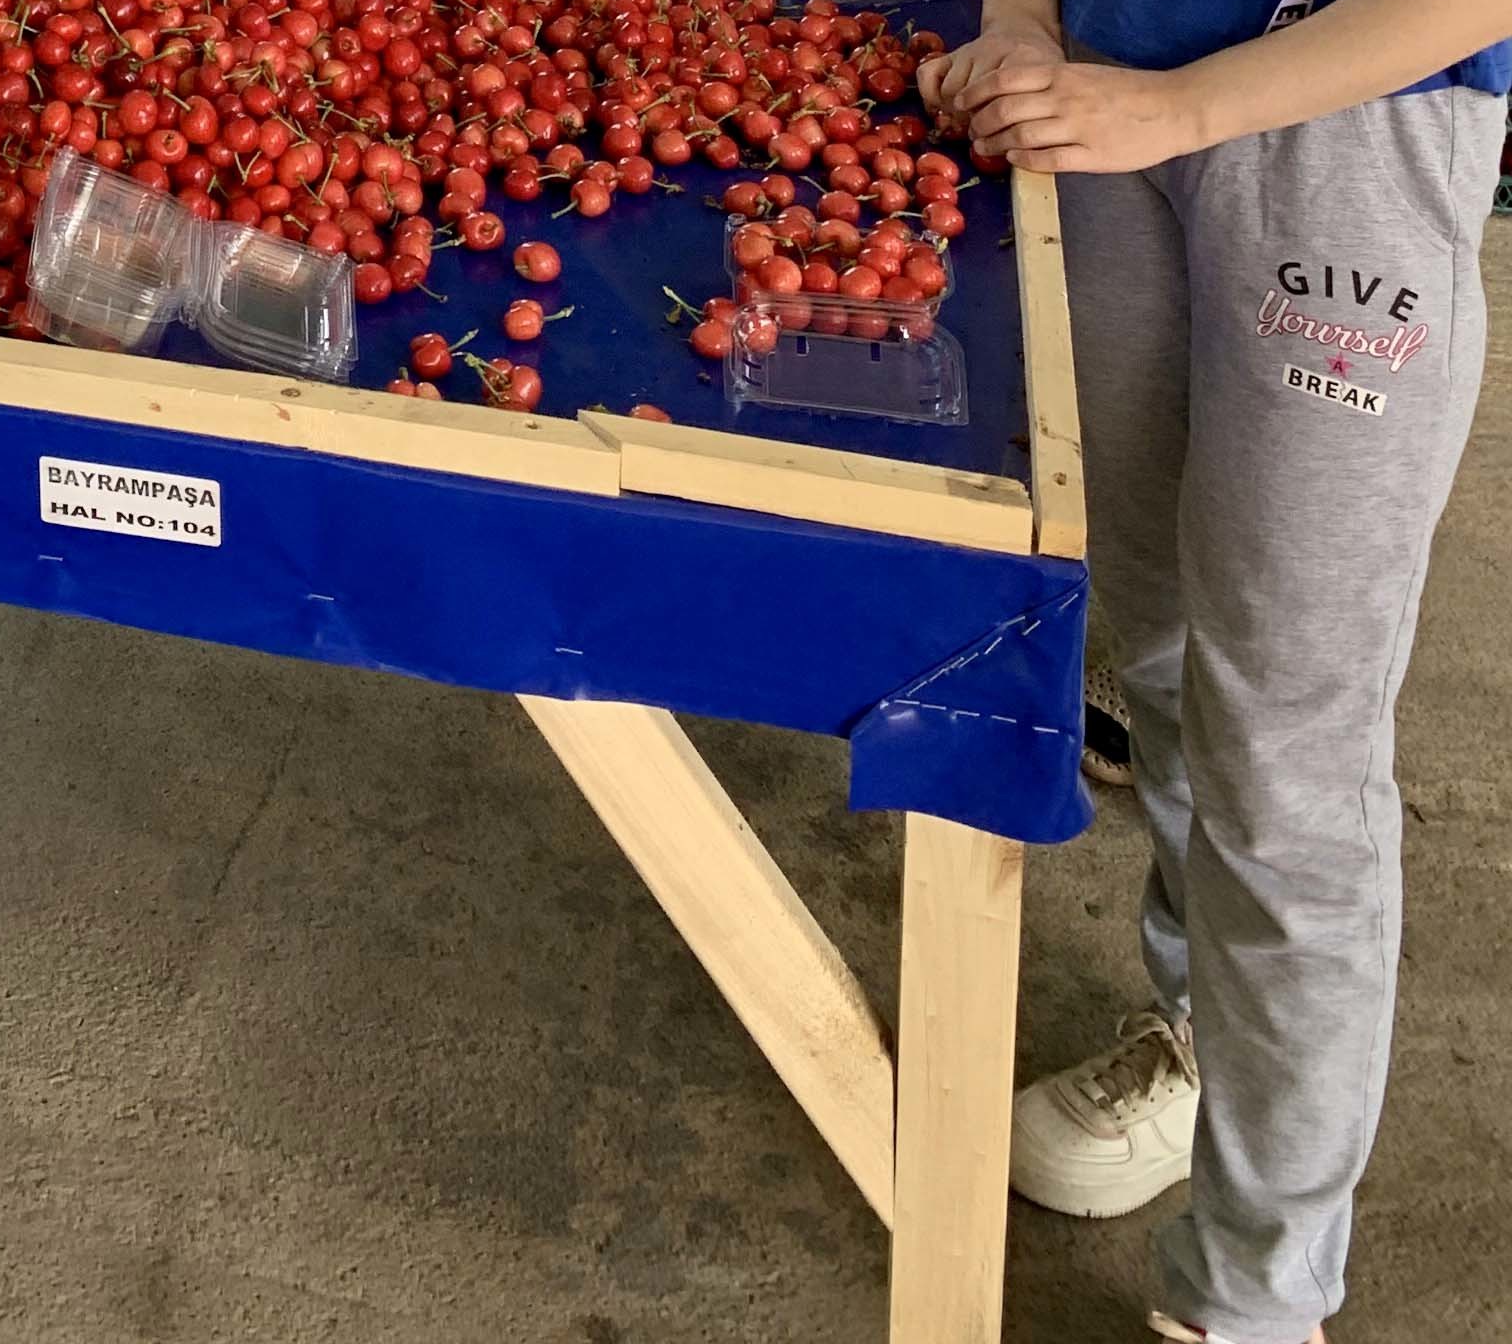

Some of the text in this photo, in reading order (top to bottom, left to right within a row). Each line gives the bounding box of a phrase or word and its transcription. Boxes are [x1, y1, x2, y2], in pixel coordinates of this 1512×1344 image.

[1277, 262, 1419, 323] GIVE
[1255, 288, 1429, 374] Yourself
[1288, 367, 1379, 413] BREAK
[47, 466, 217, 508] BAYRAMPAŞA
[50, 502, 217, 538] HAL NO:104
